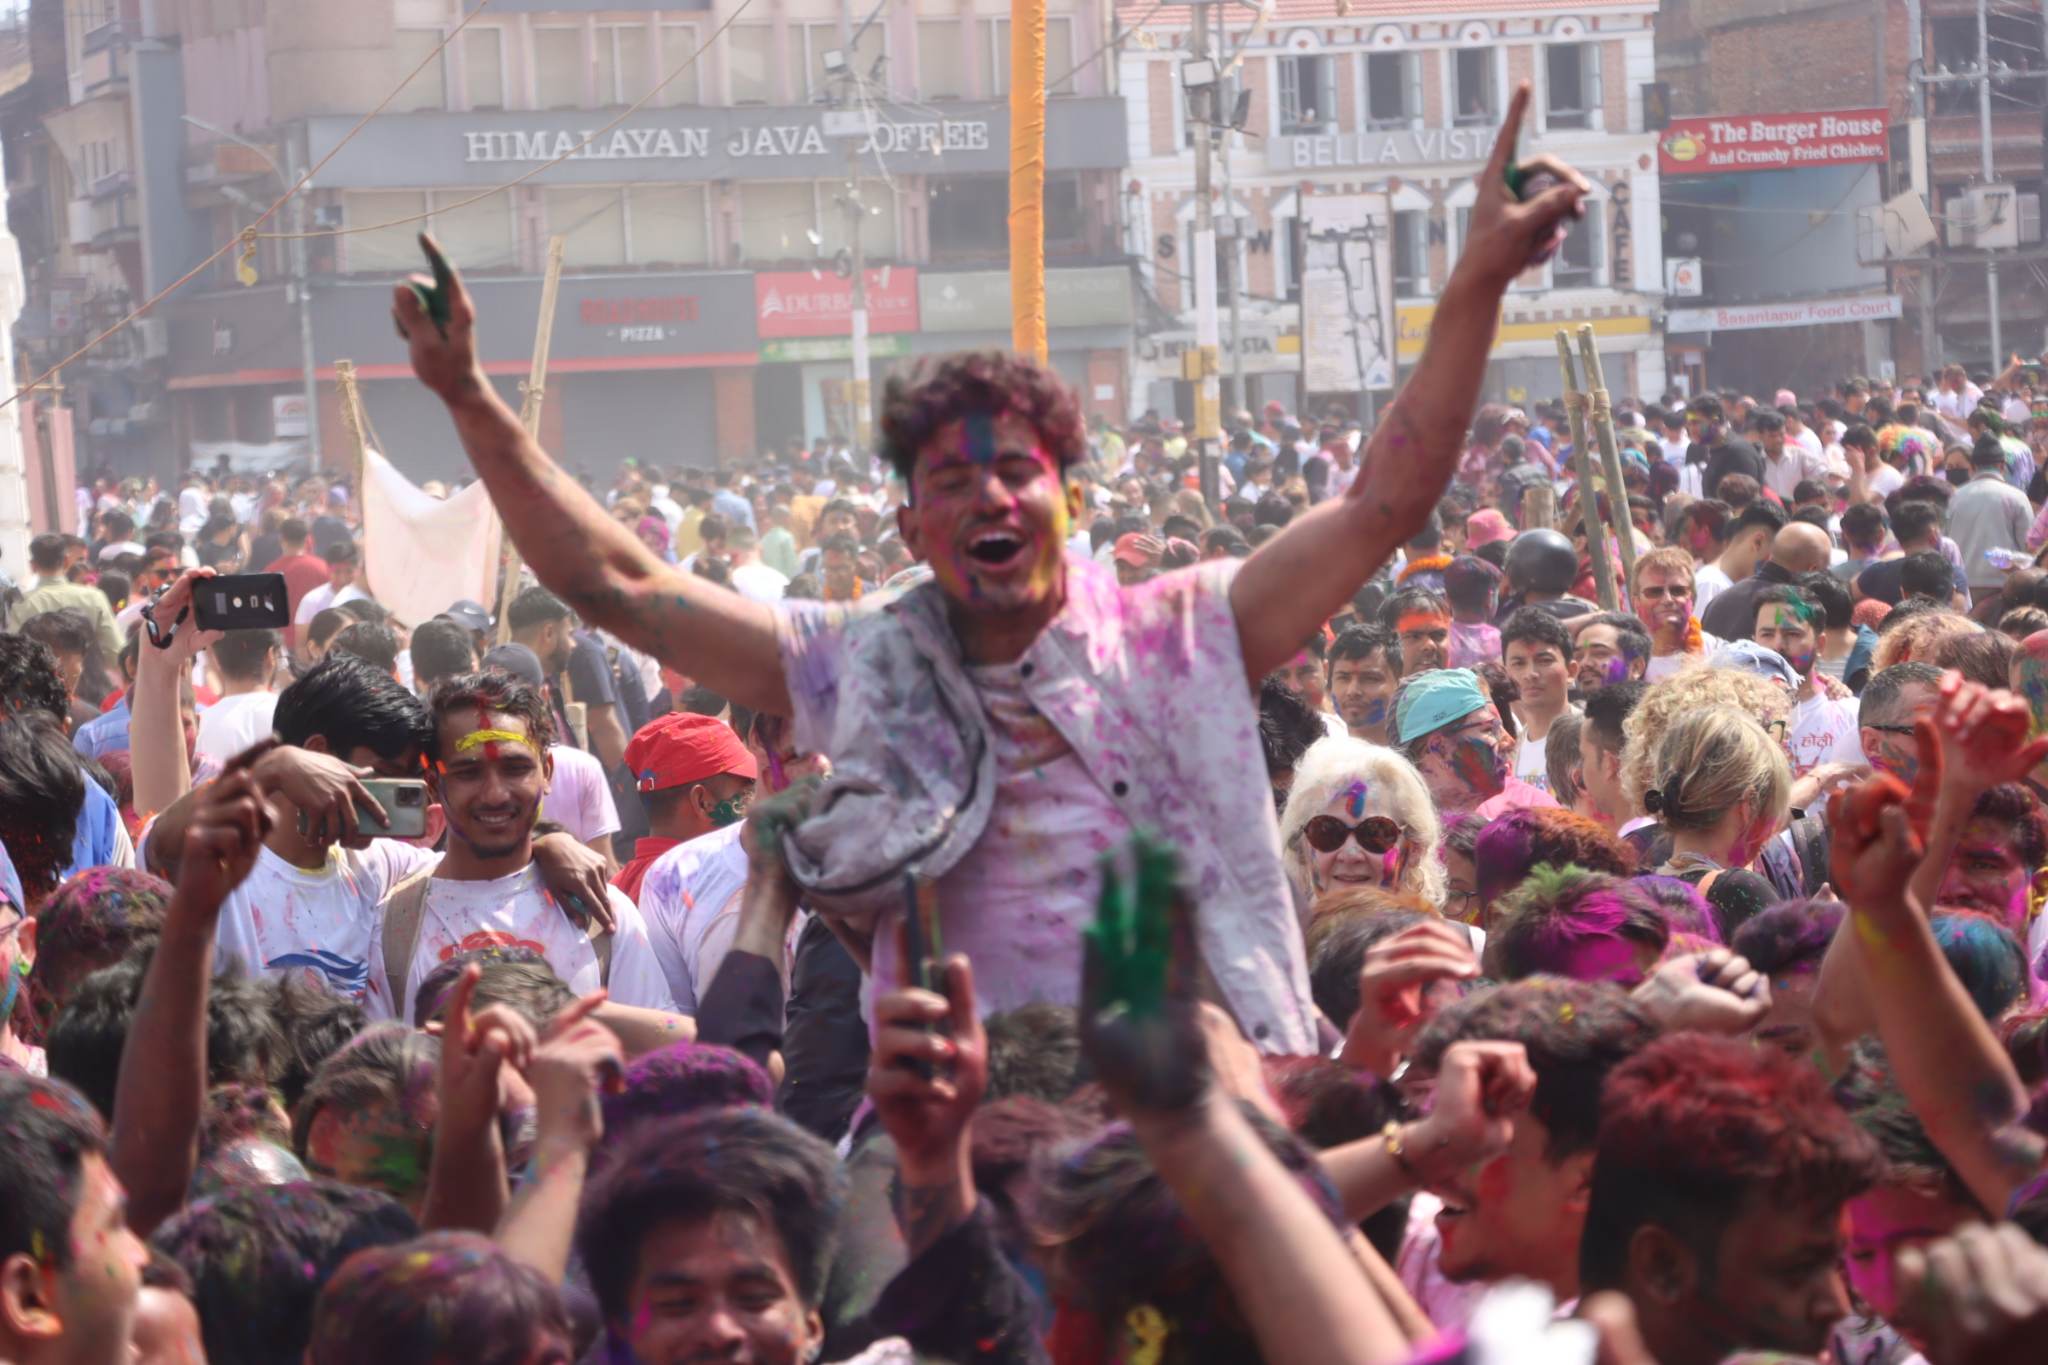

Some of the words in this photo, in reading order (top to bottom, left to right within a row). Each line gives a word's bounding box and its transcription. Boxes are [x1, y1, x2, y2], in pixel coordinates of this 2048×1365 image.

[464, 127, 711, 162] HIMALAYAN
[727, 124, 829, 157] JAVA
[1709, 122, 1749, 144] The
[1750, 119, 1817, 145] Burger
[1820, 116, 1883, 138] House
[1293, 135, 1400, 167] BELLA
[1709, 149, 1734, 165] And
[1736, 145, 1790, 164] Crunchy
[1794, 144, 1828, 161] Fried
[1612, 182, 1630, 283] CAFE
[1717, 308, 1803, 328] Basantapur
[1807, 304, 1846, 318] Food
[1850, 299, 1893, 315] Court
[620, 326, 664, 342] PIZZA
[1221, 336, 1272, 354] VSTA
